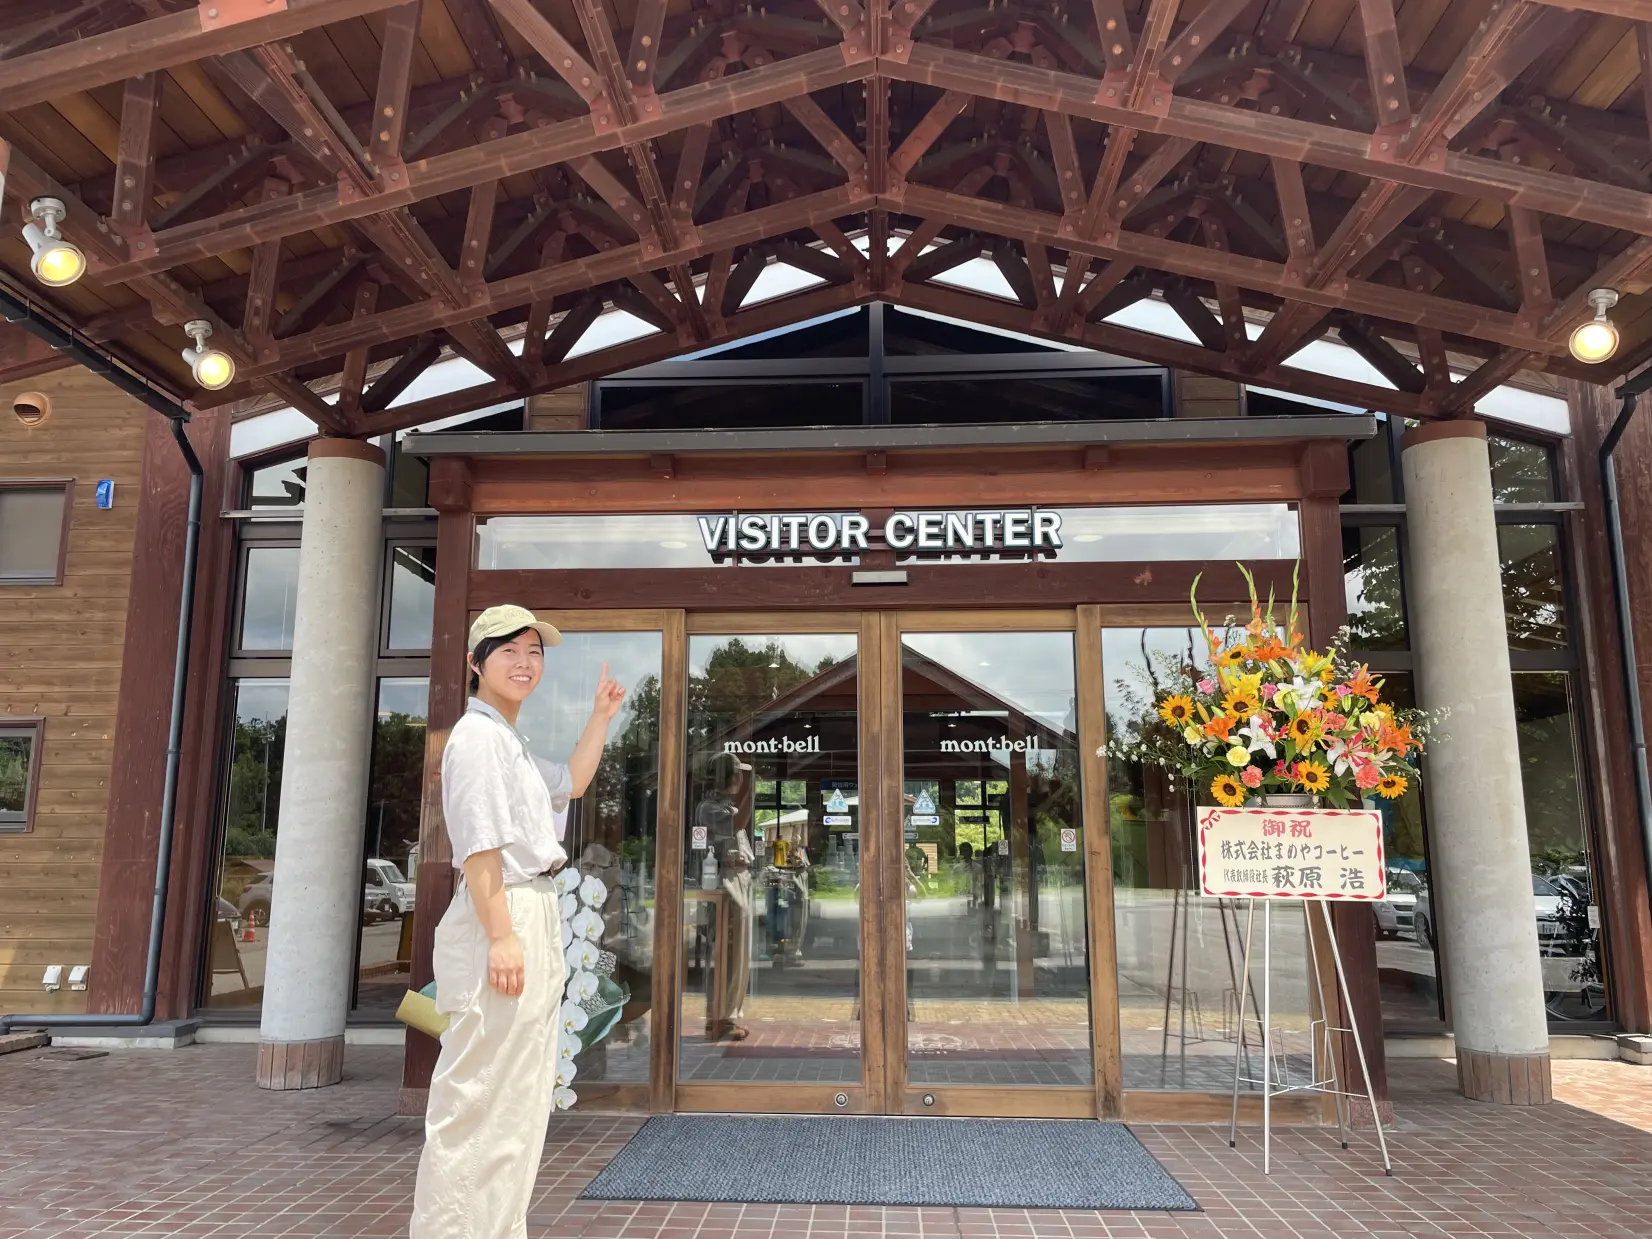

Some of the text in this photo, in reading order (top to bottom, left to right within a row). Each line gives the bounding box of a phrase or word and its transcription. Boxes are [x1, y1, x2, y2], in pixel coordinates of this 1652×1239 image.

[697, 511, 1063, 552] VISITOR CENTER
[1263, 820, 1312, 837] 御祝
[1221, 840, 1364, 861] 株式会社まめやコーヒー
[1224, 869, 1268, 883] 代表取締役社長
[1340, 867, 1365, 890] 浩
